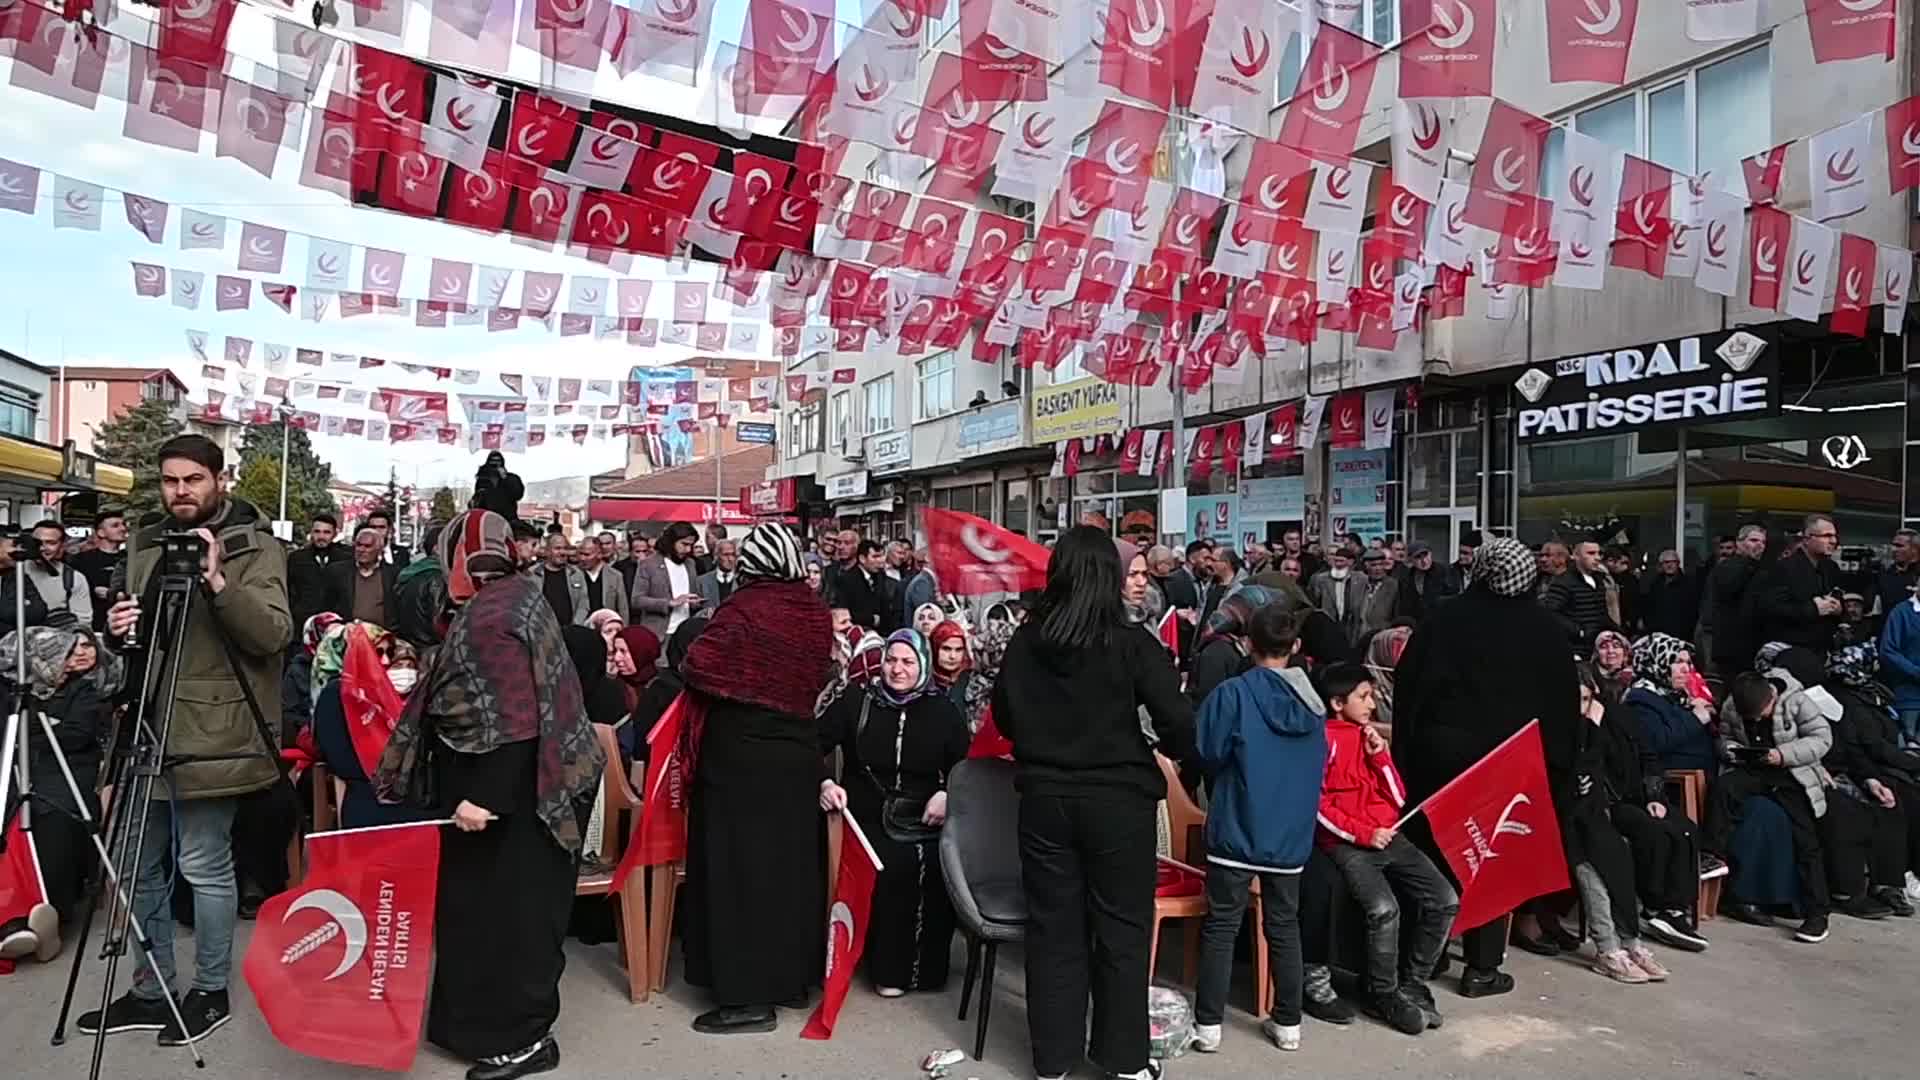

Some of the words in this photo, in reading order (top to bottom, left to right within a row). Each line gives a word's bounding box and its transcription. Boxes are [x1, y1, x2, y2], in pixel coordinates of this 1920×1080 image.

[1557, 360, 1581, 373] NSC
[1585, 337, 1711, 387] KRAL
[1082, 383, 1117, 408] YUFKA
